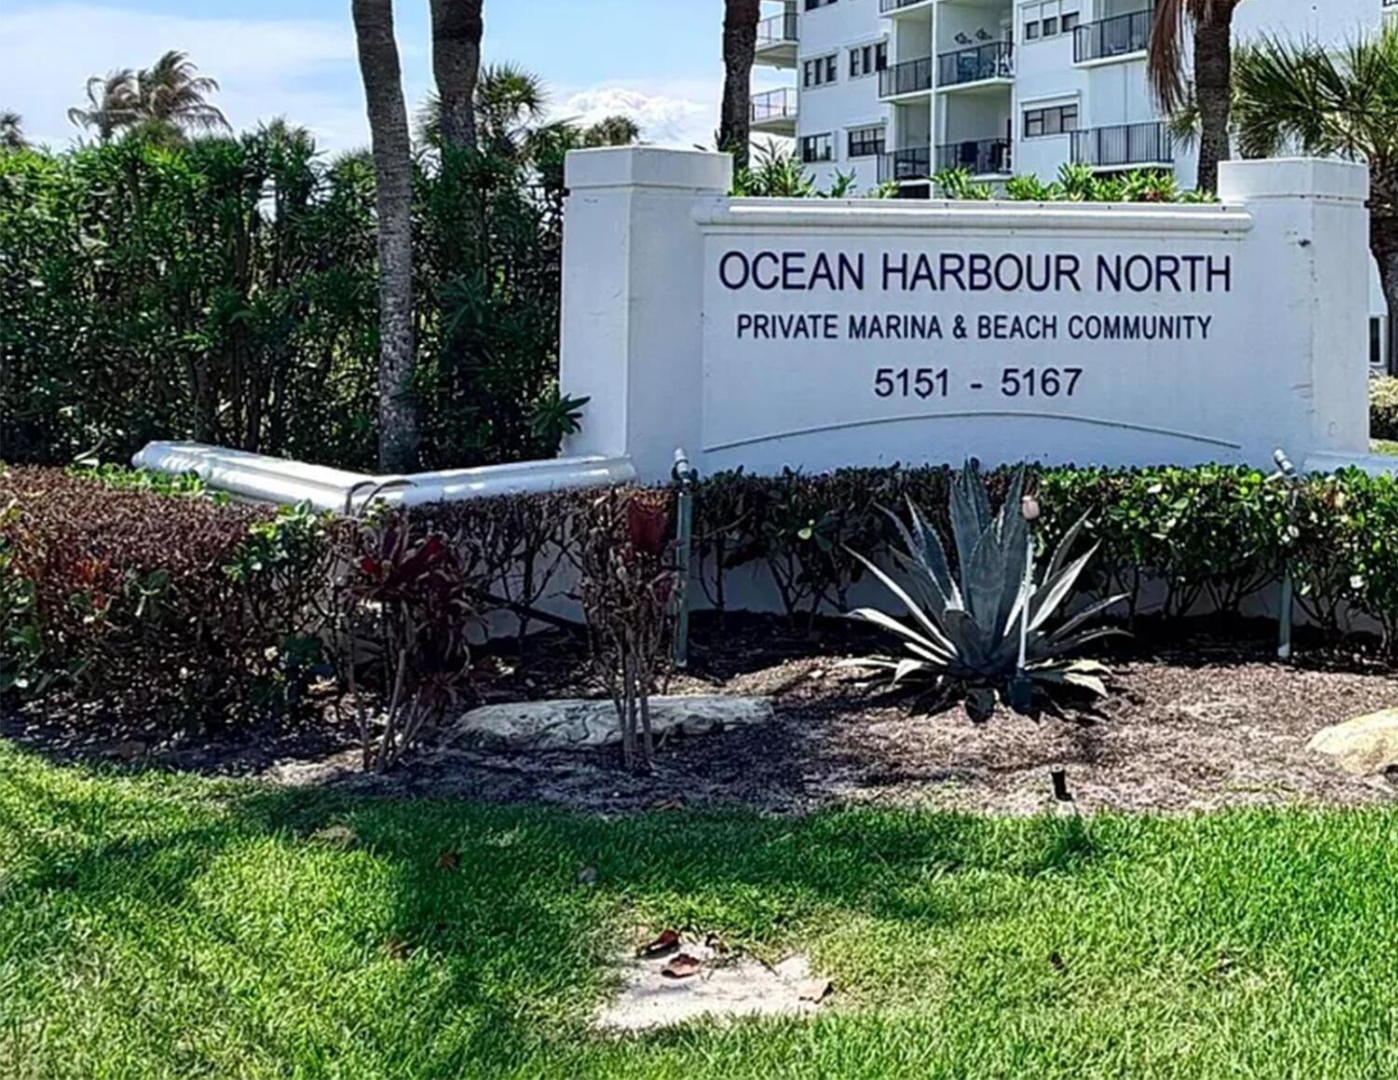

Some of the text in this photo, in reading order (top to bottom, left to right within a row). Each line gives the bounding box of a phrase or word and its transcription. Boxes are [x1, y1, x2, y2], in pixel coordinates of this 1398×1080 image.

[718, 250, 1231, 293] OCEAN HARBOUR NORTH
[736, 313, 1212, 341] PRIVATE MARINA & BEACH COMMUNITY
[874, 367, 1084, 399] 5151 - 5167
